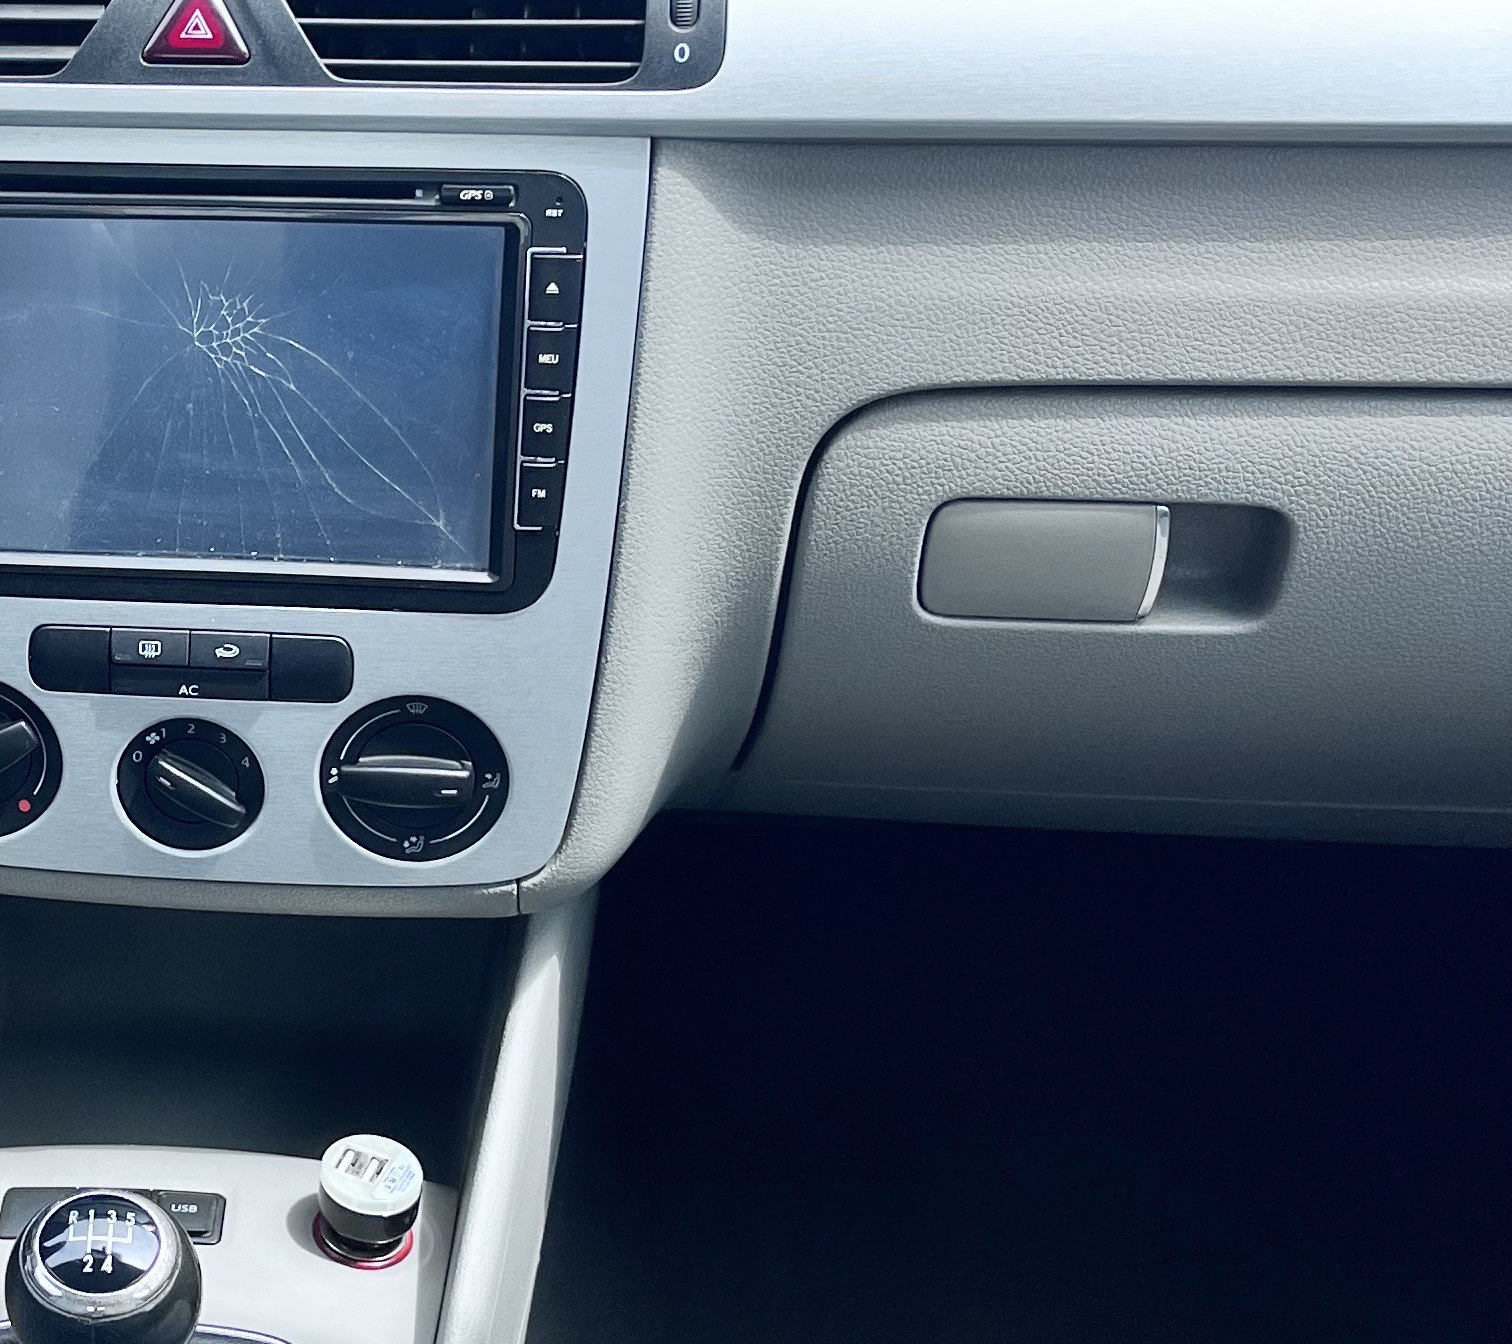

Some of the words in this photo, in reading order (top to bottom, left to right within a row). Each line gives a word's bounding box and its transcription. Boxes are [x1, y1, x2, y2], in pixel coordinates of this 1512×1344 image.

[674, 43, 690, 63] 0
[459, 190, 484, 200] GPS
[533, 423, 553, 433] GPS
[531, 489, 546, 498] FM
[178, 684, 199, 696] AC
[160, 727, 166, 739] 1
[187, 723, 196, 734] 2
[218, 733, 227, 744] 3
[132, 751, 143, 763] 0
[241, 756, 250, 768] 4
[171, 1203, 198, 1213] USB
[68, 1209, 79, 1225] R
[88, 1209, 96, 1224] 1
[107, 1209, 117, 1224] 3
[126, 1212, 136, 1226] 5
[82, 1253, 94, 1273] 2
[100, 1254, 113, 1274] 4
